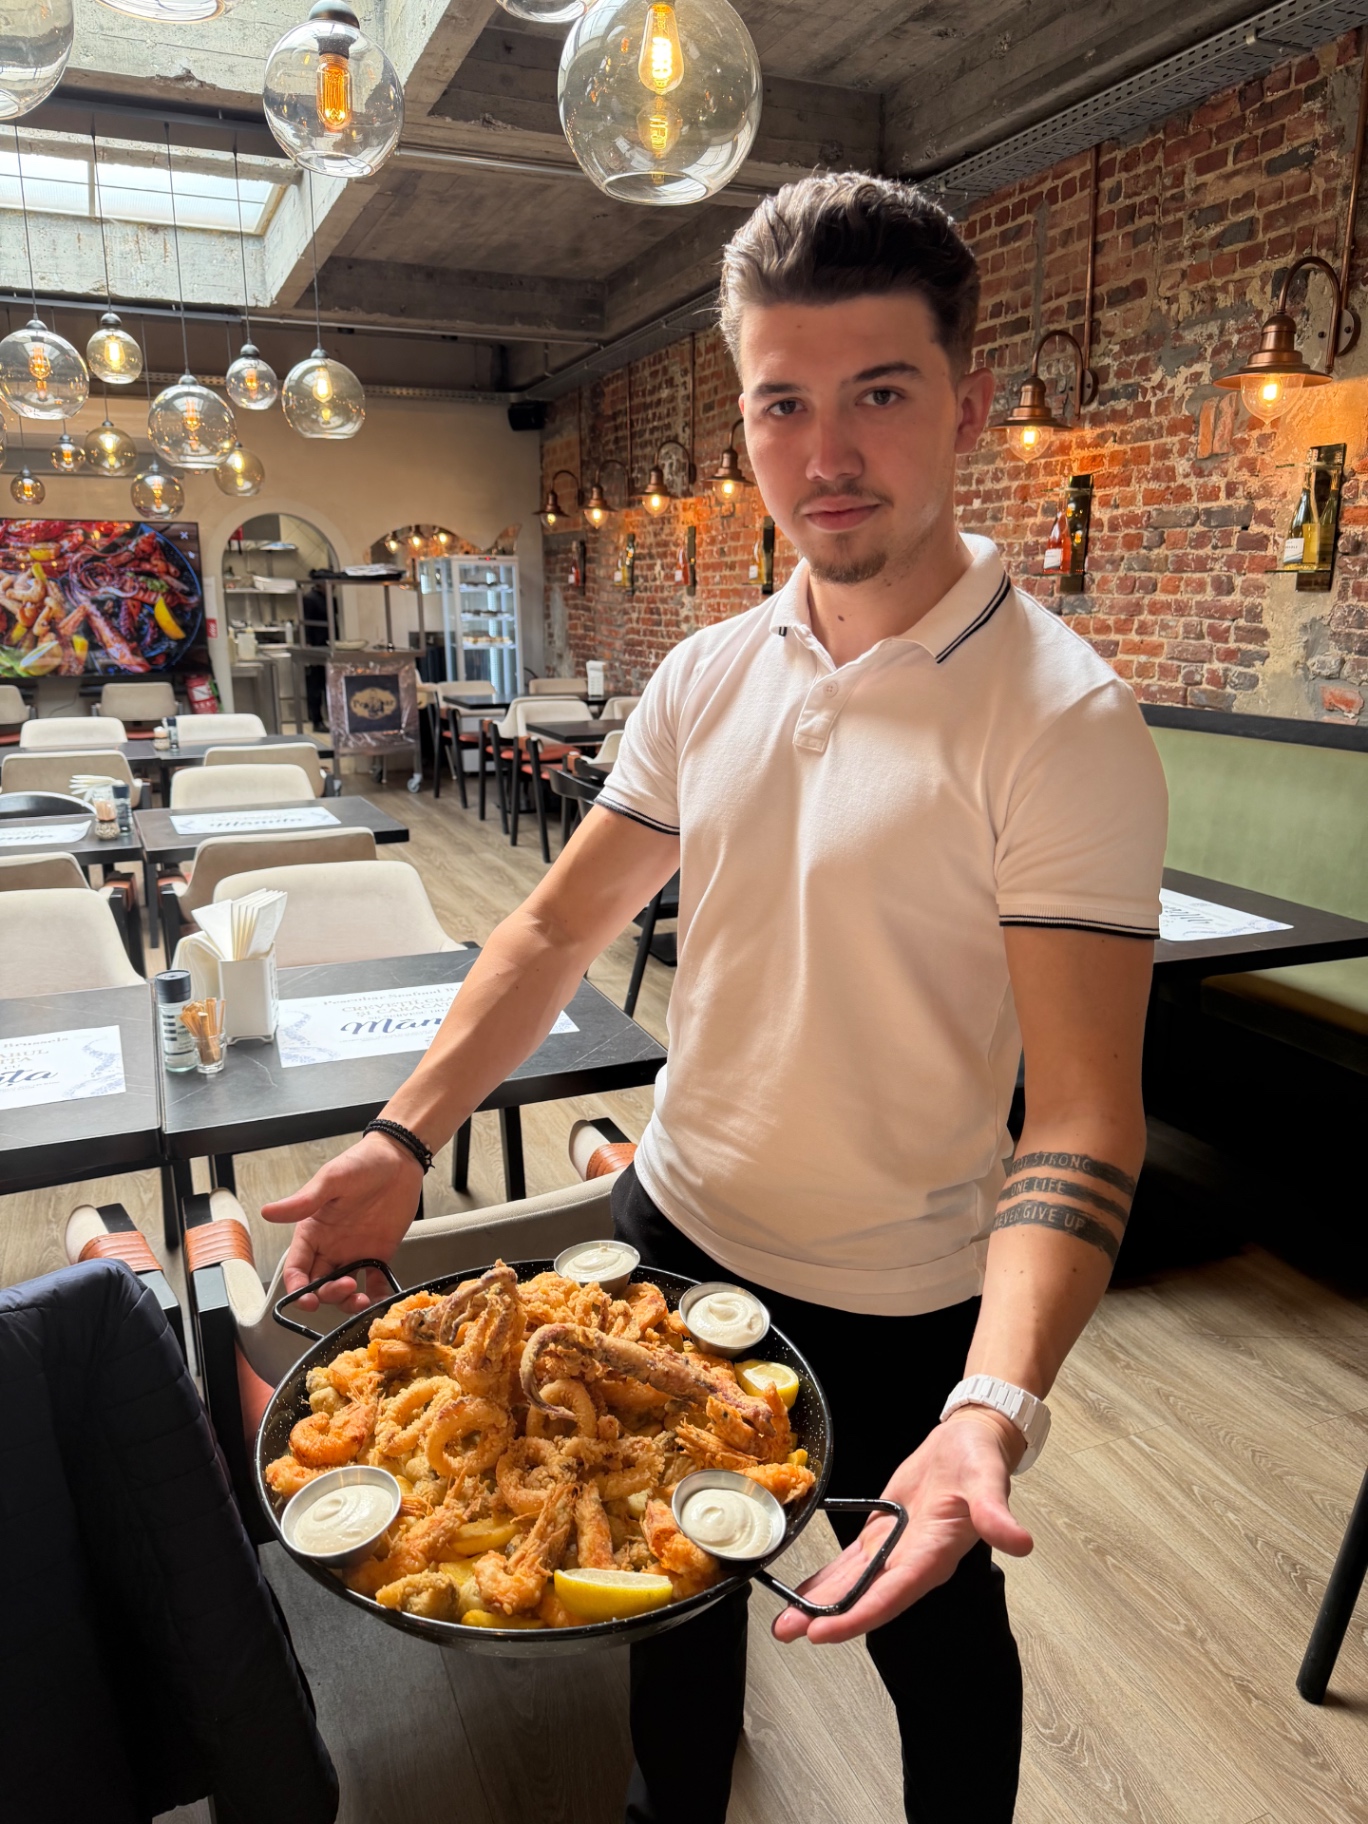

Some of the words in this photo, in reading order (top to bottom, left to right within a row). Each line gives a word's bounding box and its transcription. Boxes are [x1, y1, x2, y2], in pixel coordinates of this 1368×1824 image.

[377, 1002, 452, 1014] CARACAT
[427, 996, 454, 1006] CRA
[1033, 1152, 1092, 1171] STRONG
[1010, 1180, 1029, 1196] ONE
[1033, 1179, 1066, 1194] LIFE
[993, 1209, 1020, 1228] NEVER
[1023, 1204, 1058, 1222] GIVE
[1064, 1213, 1086, 1231] UP
